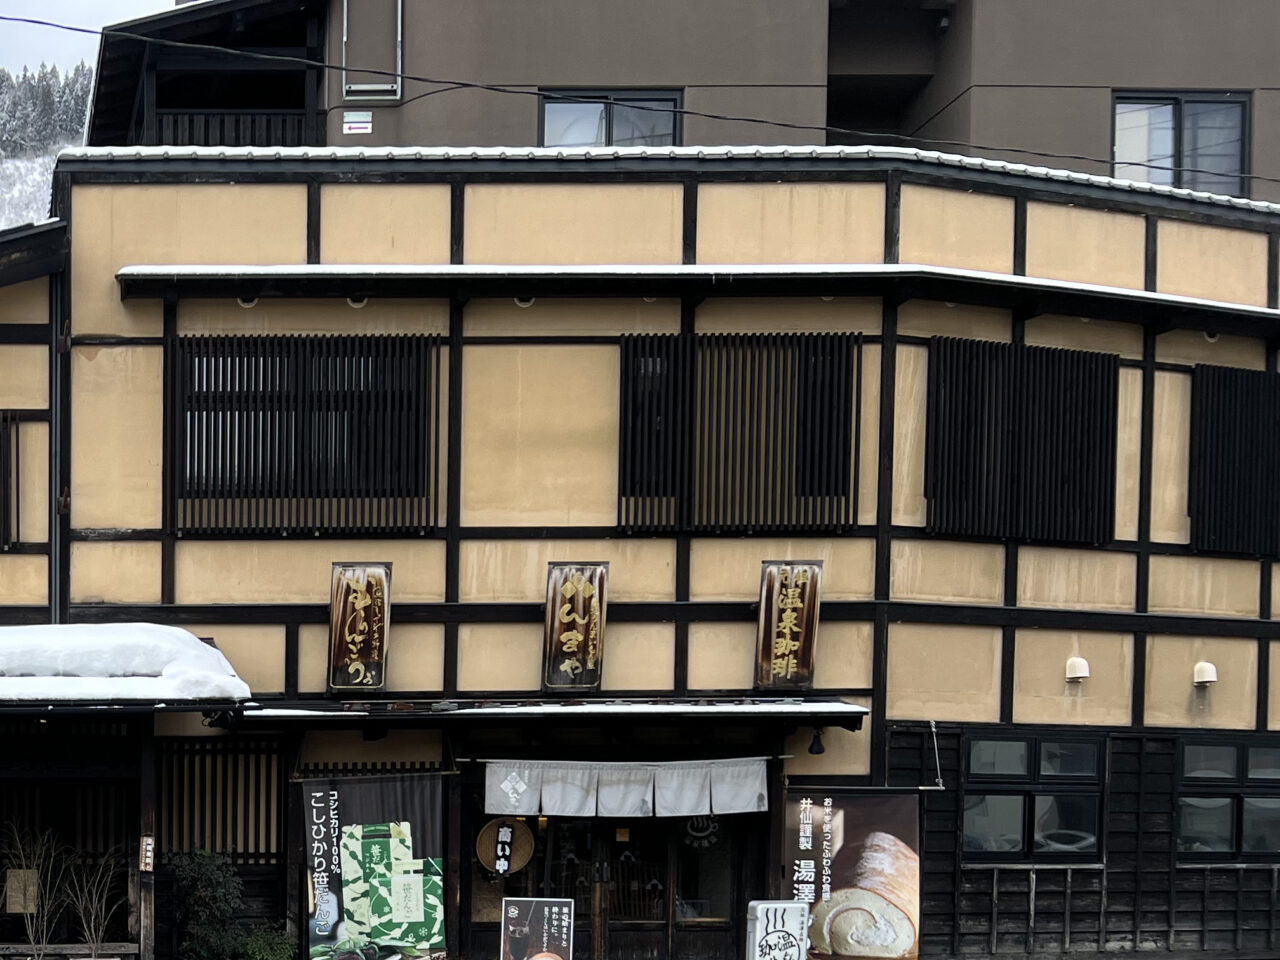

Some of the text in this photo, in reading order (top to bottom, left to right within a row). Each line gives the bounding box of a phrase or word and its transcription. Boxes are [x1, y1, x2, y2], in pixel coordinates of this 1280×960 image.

[772, 587, 804, 680] 温泉珈琲
[311, 792, 330, 936] こしひかり笹だんご
[329, 791, 341, 874] コシヒカリ100%
[495, 826, 513, 874] 商い中
